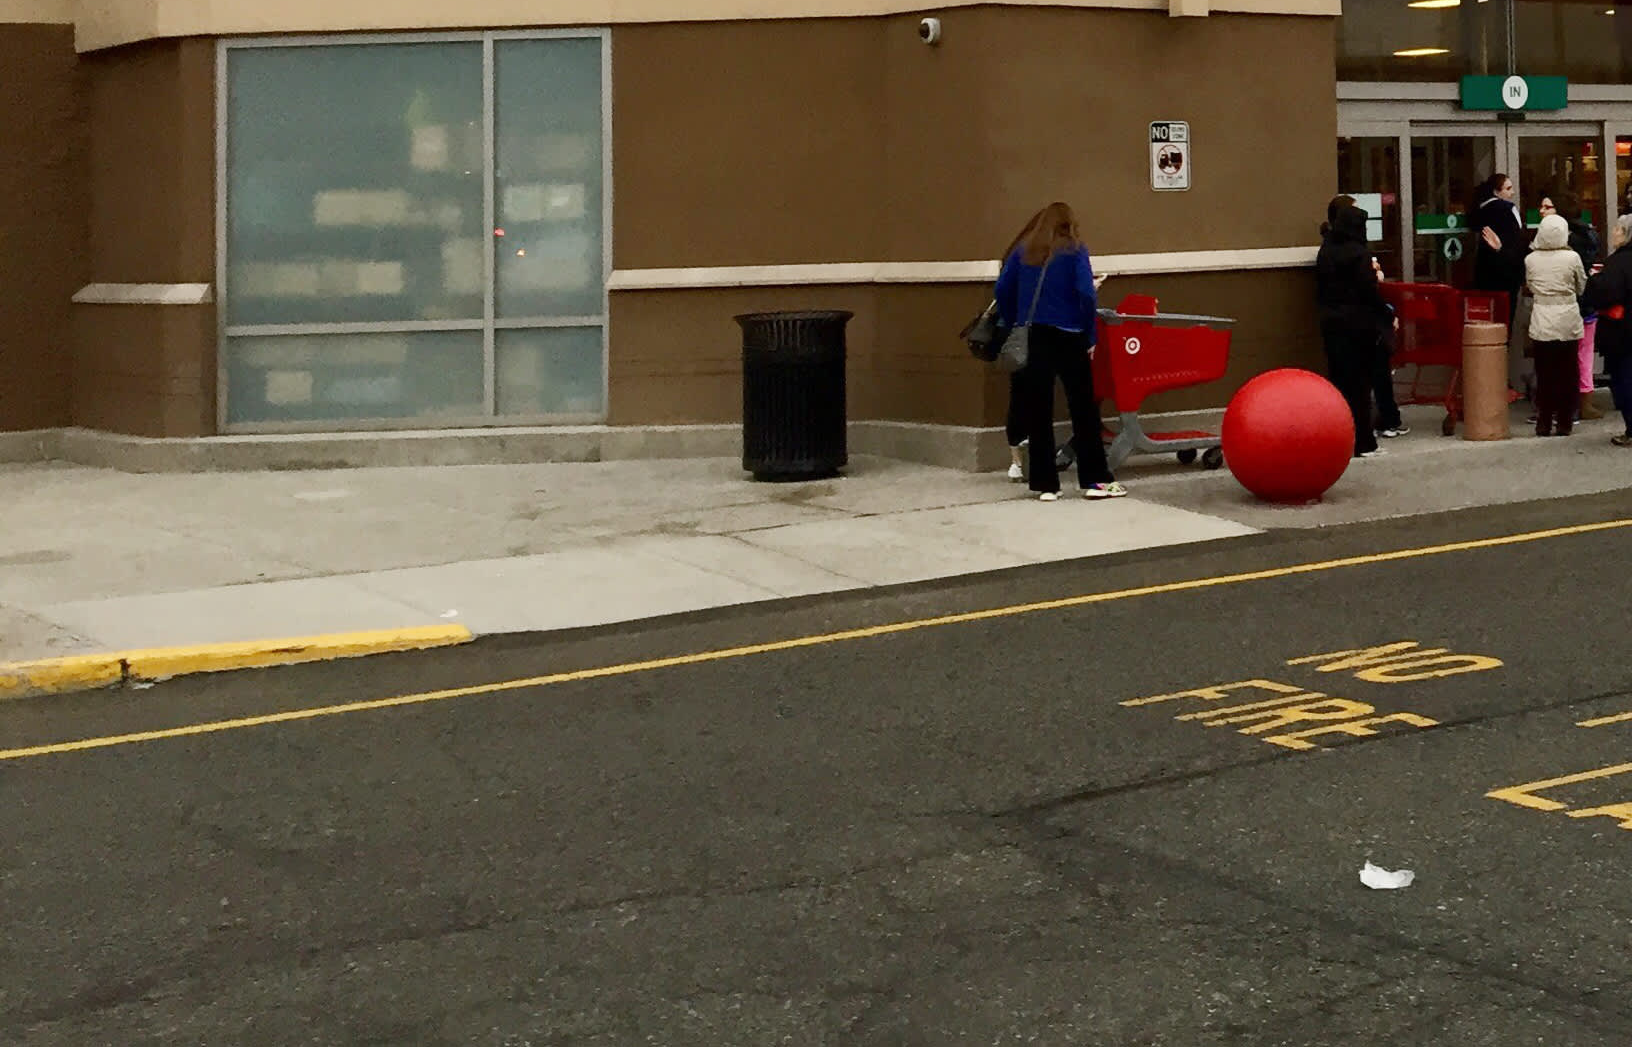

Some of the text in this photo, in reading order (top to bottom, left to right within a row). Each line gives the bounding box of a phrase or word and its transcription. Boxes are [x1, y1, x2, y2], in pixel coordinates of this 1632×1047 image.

[1509, 86, 1521, 98] IN
[1152, 126, 1169, 140] NO
[1286, 641, 1504, 683] NO
[1118, 678, 1442, 750] FIRE
